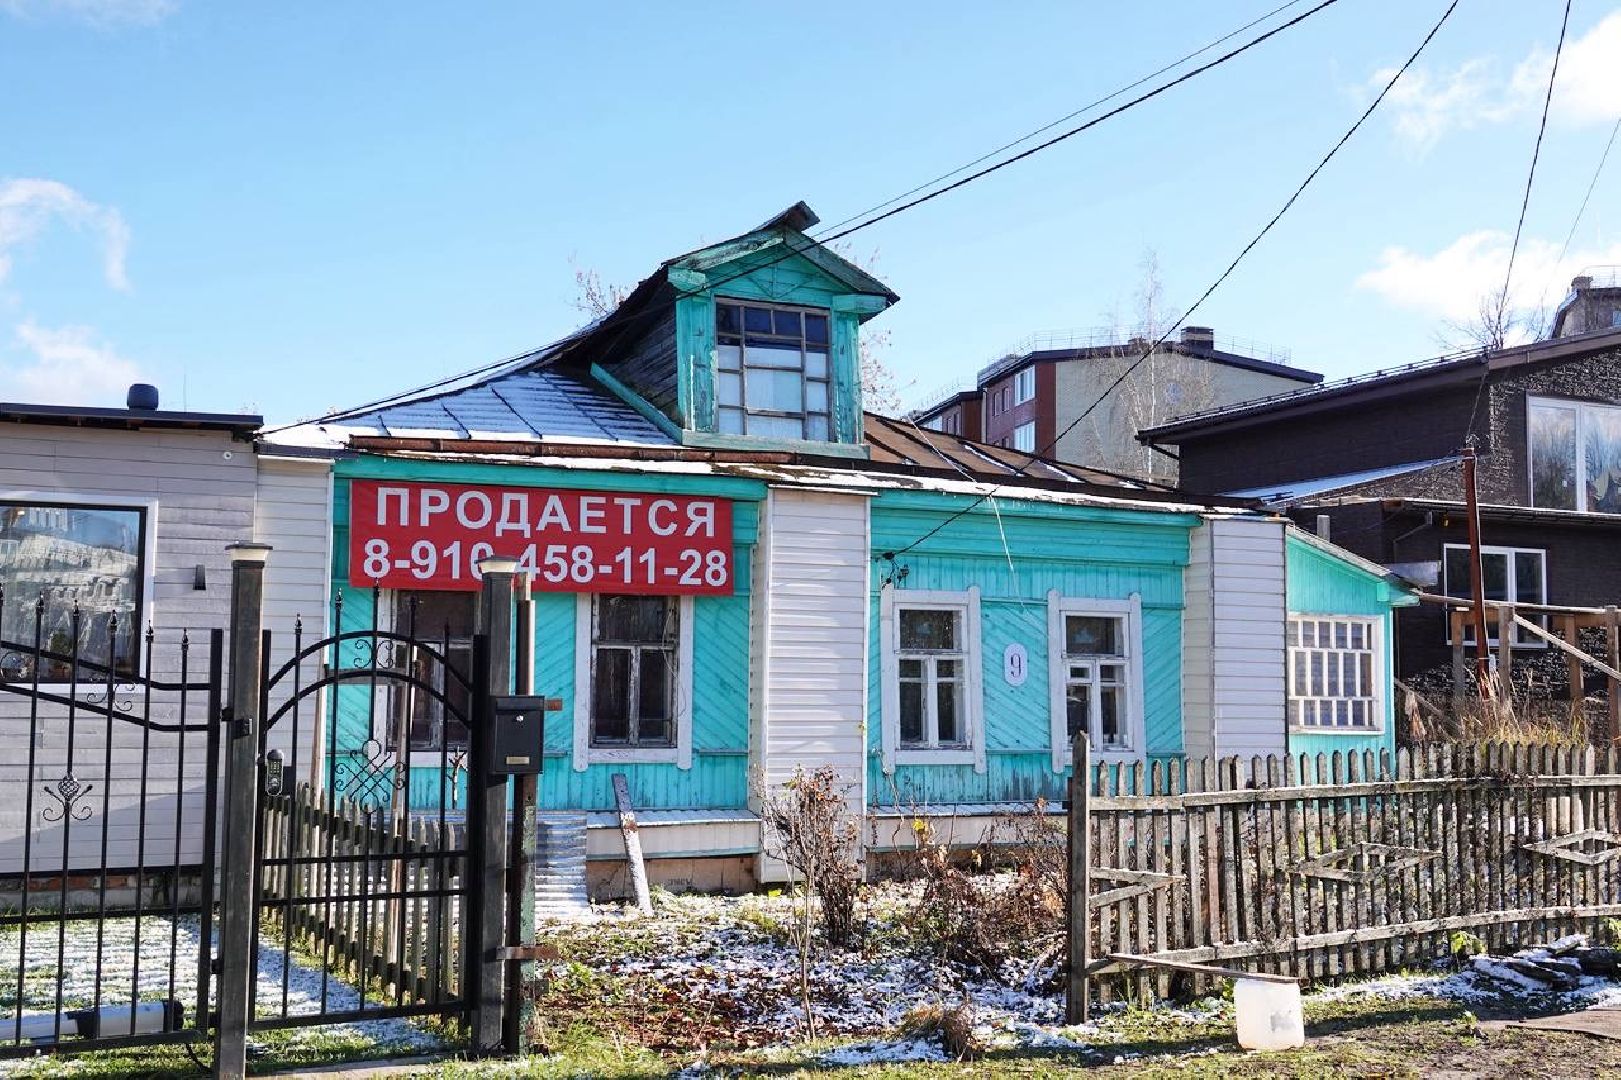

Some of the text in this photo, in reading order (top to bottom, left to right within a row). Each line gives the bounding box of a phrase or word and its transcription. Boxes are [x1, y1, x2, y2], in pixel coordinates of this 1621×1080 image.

[377, 487, 715, 538] ПРОДАЕТСЯ
[363, 538, 727, 587] 8-910458-11-28
[1010, 653, 1022, 678] 9
